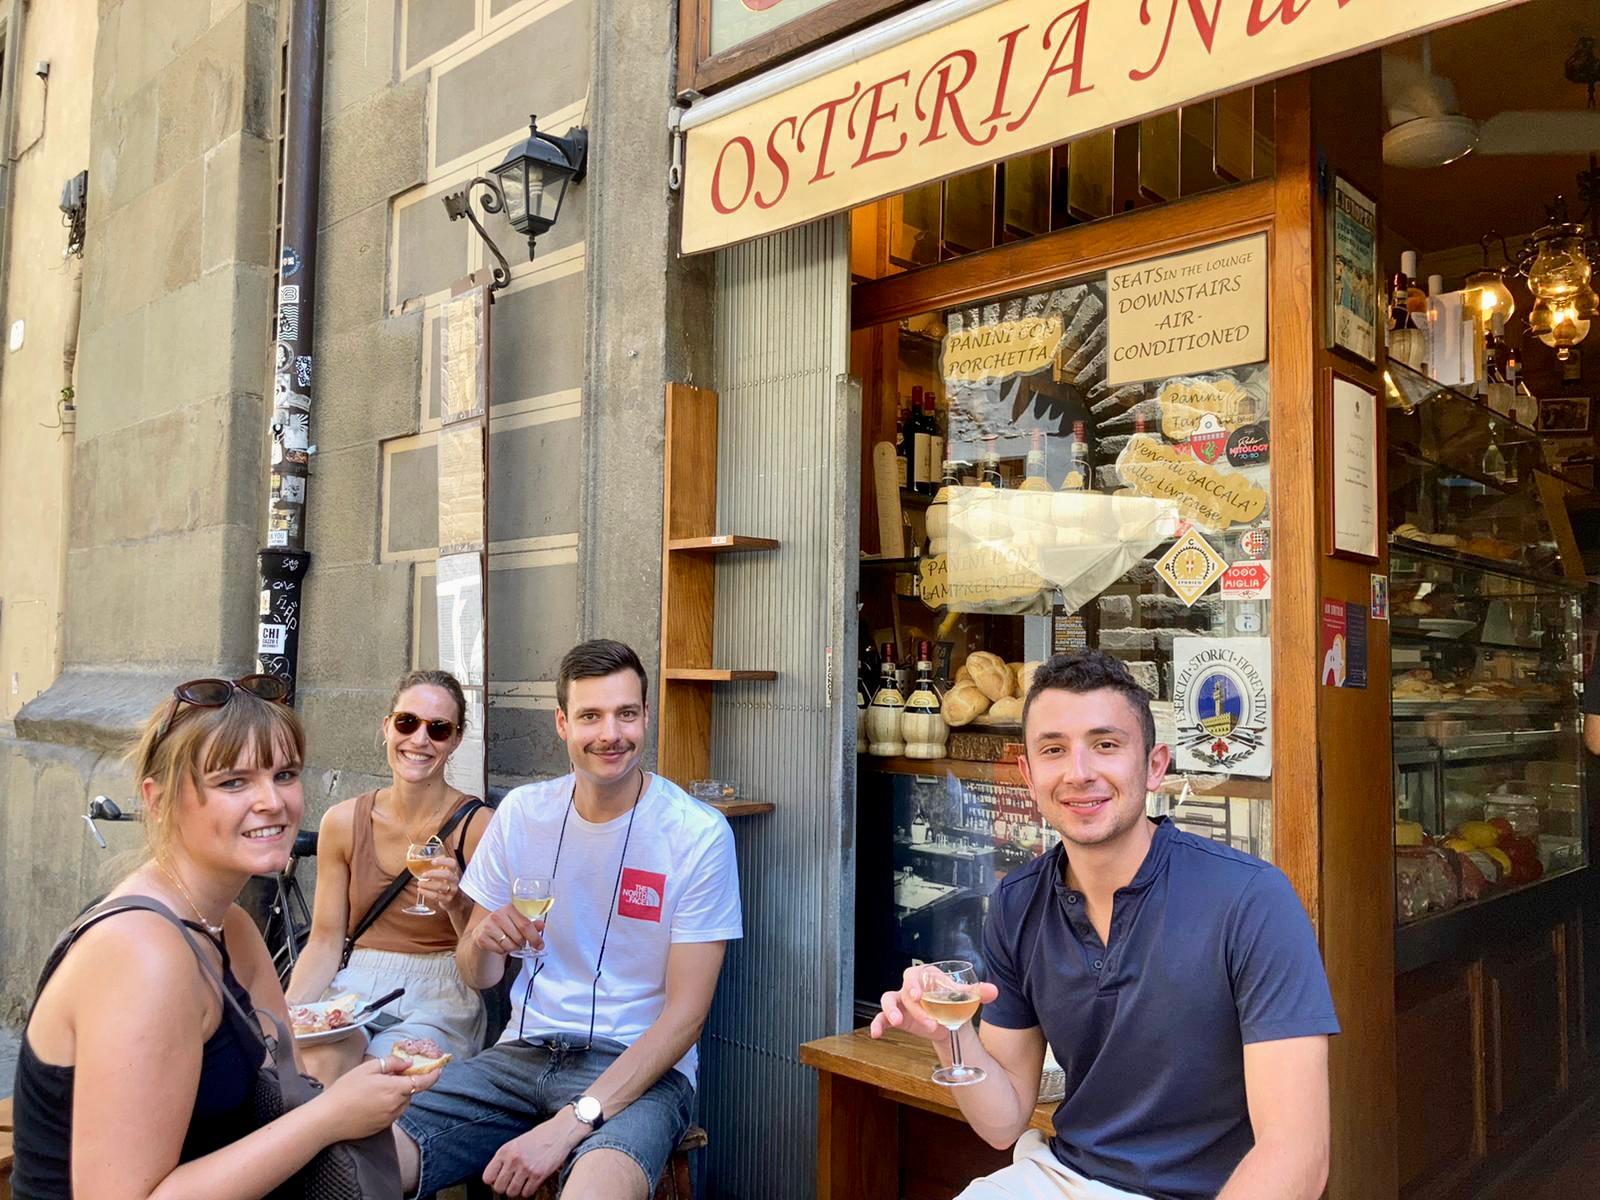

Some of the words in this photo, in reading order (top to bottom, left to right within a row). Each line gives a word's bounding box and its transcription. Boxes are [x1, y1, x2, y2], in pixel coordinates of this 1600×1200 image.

[711, 8, 1095, 214] OSTERIA
[1129, 0, 1362, 81] Nu
[1111, 265, 1164, 291] SEATS
[1163, 268, 1178, 282] IN
[1181, 263, 1204, 280] THE
[1205, 252, 1254, 273] LOUNGE
[1119, 275, 1242, 314] DOWNSTAIRS
[950, 326, 1014, 353] PANINI
[1018, 318, 1056, 341] CON
[1113, 324, 1250, 362] CONDITIONED
[949, 345, 1048, 375] PORCHETTA
[1169, 389, 1224, 404] Panini
[1157, 477, 1223, 521] Livornese
[928, 551, 989, 576] PANINI
[1225, 579, 1260, 588] MIGLIA
[263, 627, 280, 639] CHI
[1174, 668, 1192, 723] ESERCIZI
[1190, 648, 1234, 670] STORICI
[1236, 657, 1267, 724] FIORENTINI
[622, 889, 648, 900] NORTH
[626, 895, 649, 906] FACE
[635, 884, 648, 893] THE
